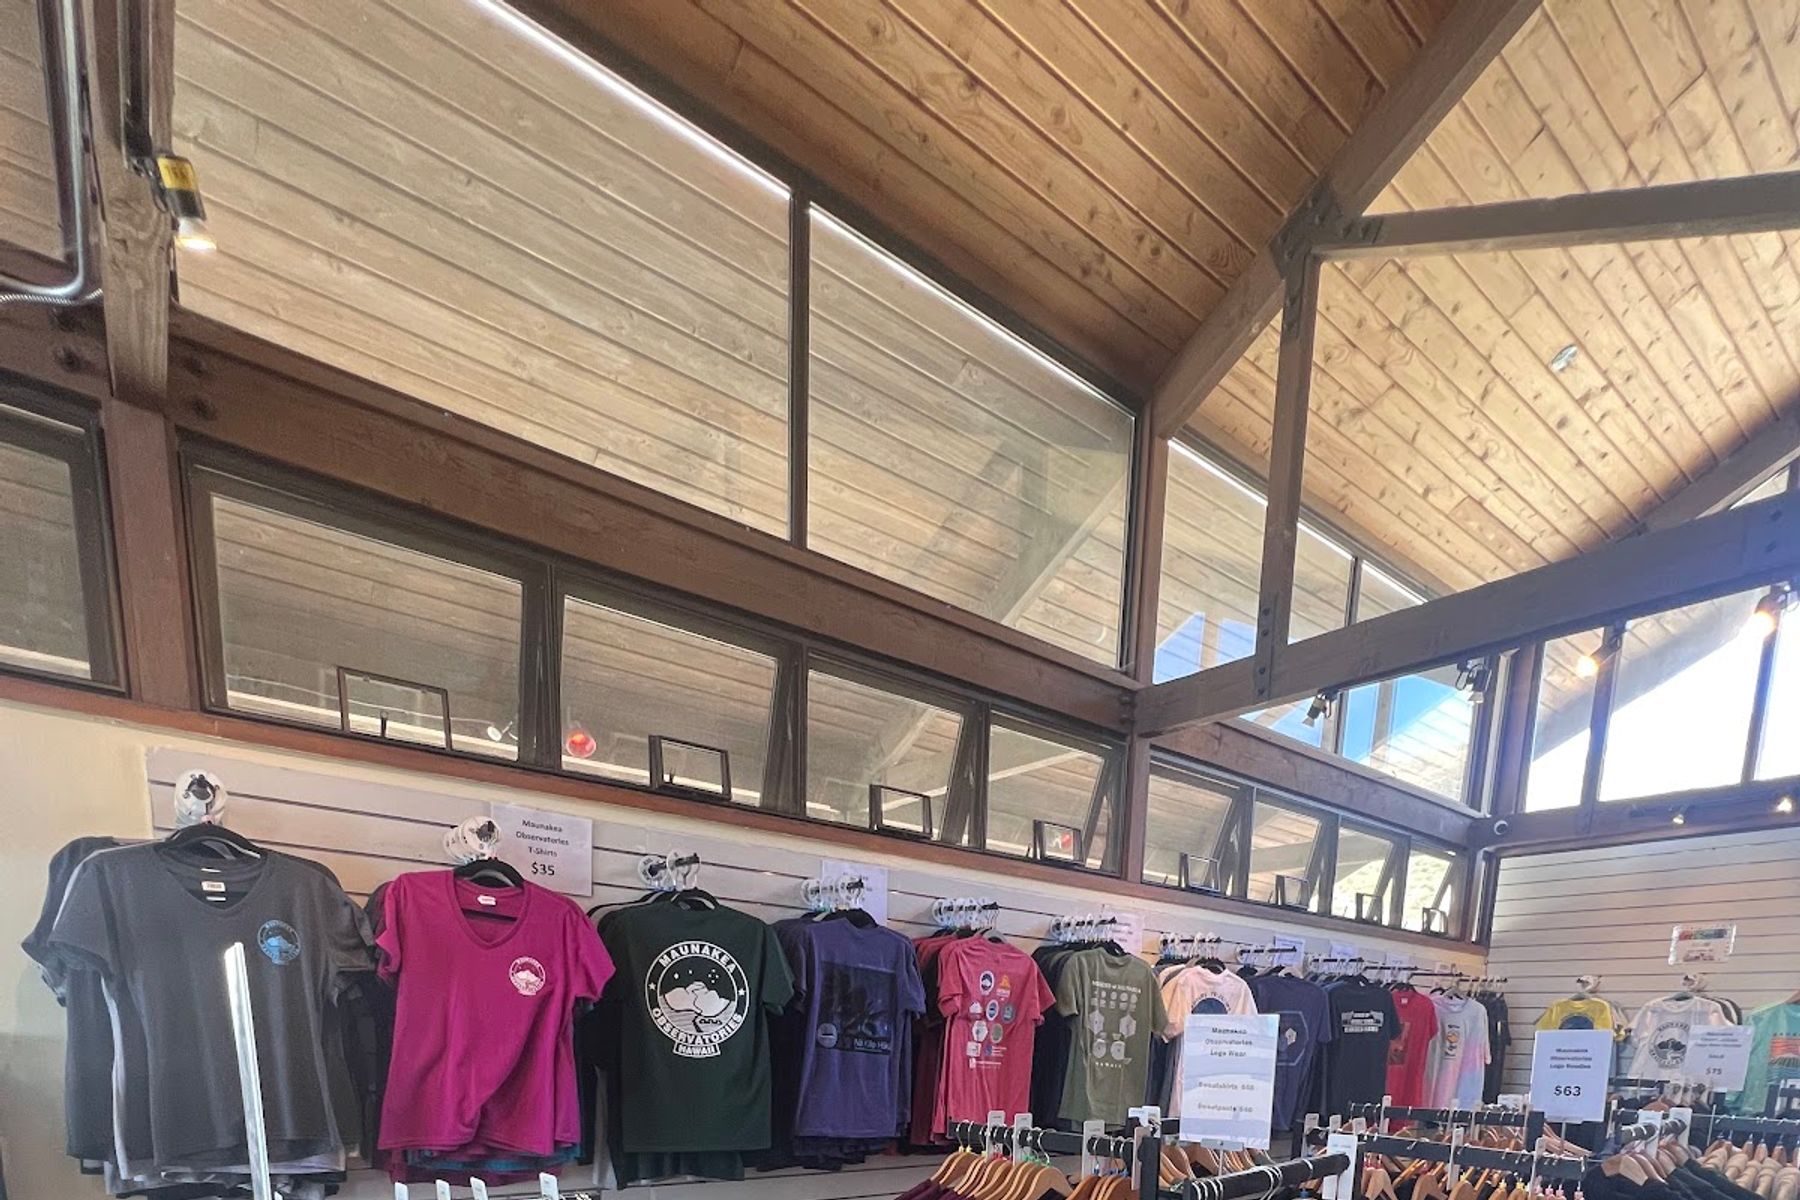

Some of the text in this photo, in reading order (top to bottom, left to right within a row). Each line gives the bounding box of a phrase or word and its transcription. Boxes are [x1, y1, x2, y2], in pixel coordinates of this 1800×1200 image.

[522, 819, 562, 833] Maunakea
[516, 831, 569, 846] Observatories
[528, 846, 558, 858] T-Shirts
[531, 861, 555, 876] $35
[659, 944, 736, 974] MAUNAKEA
[652, 1007, 743, 1045] OBSERVATORIES
[1554, 1085, 1582, 1097] $63
